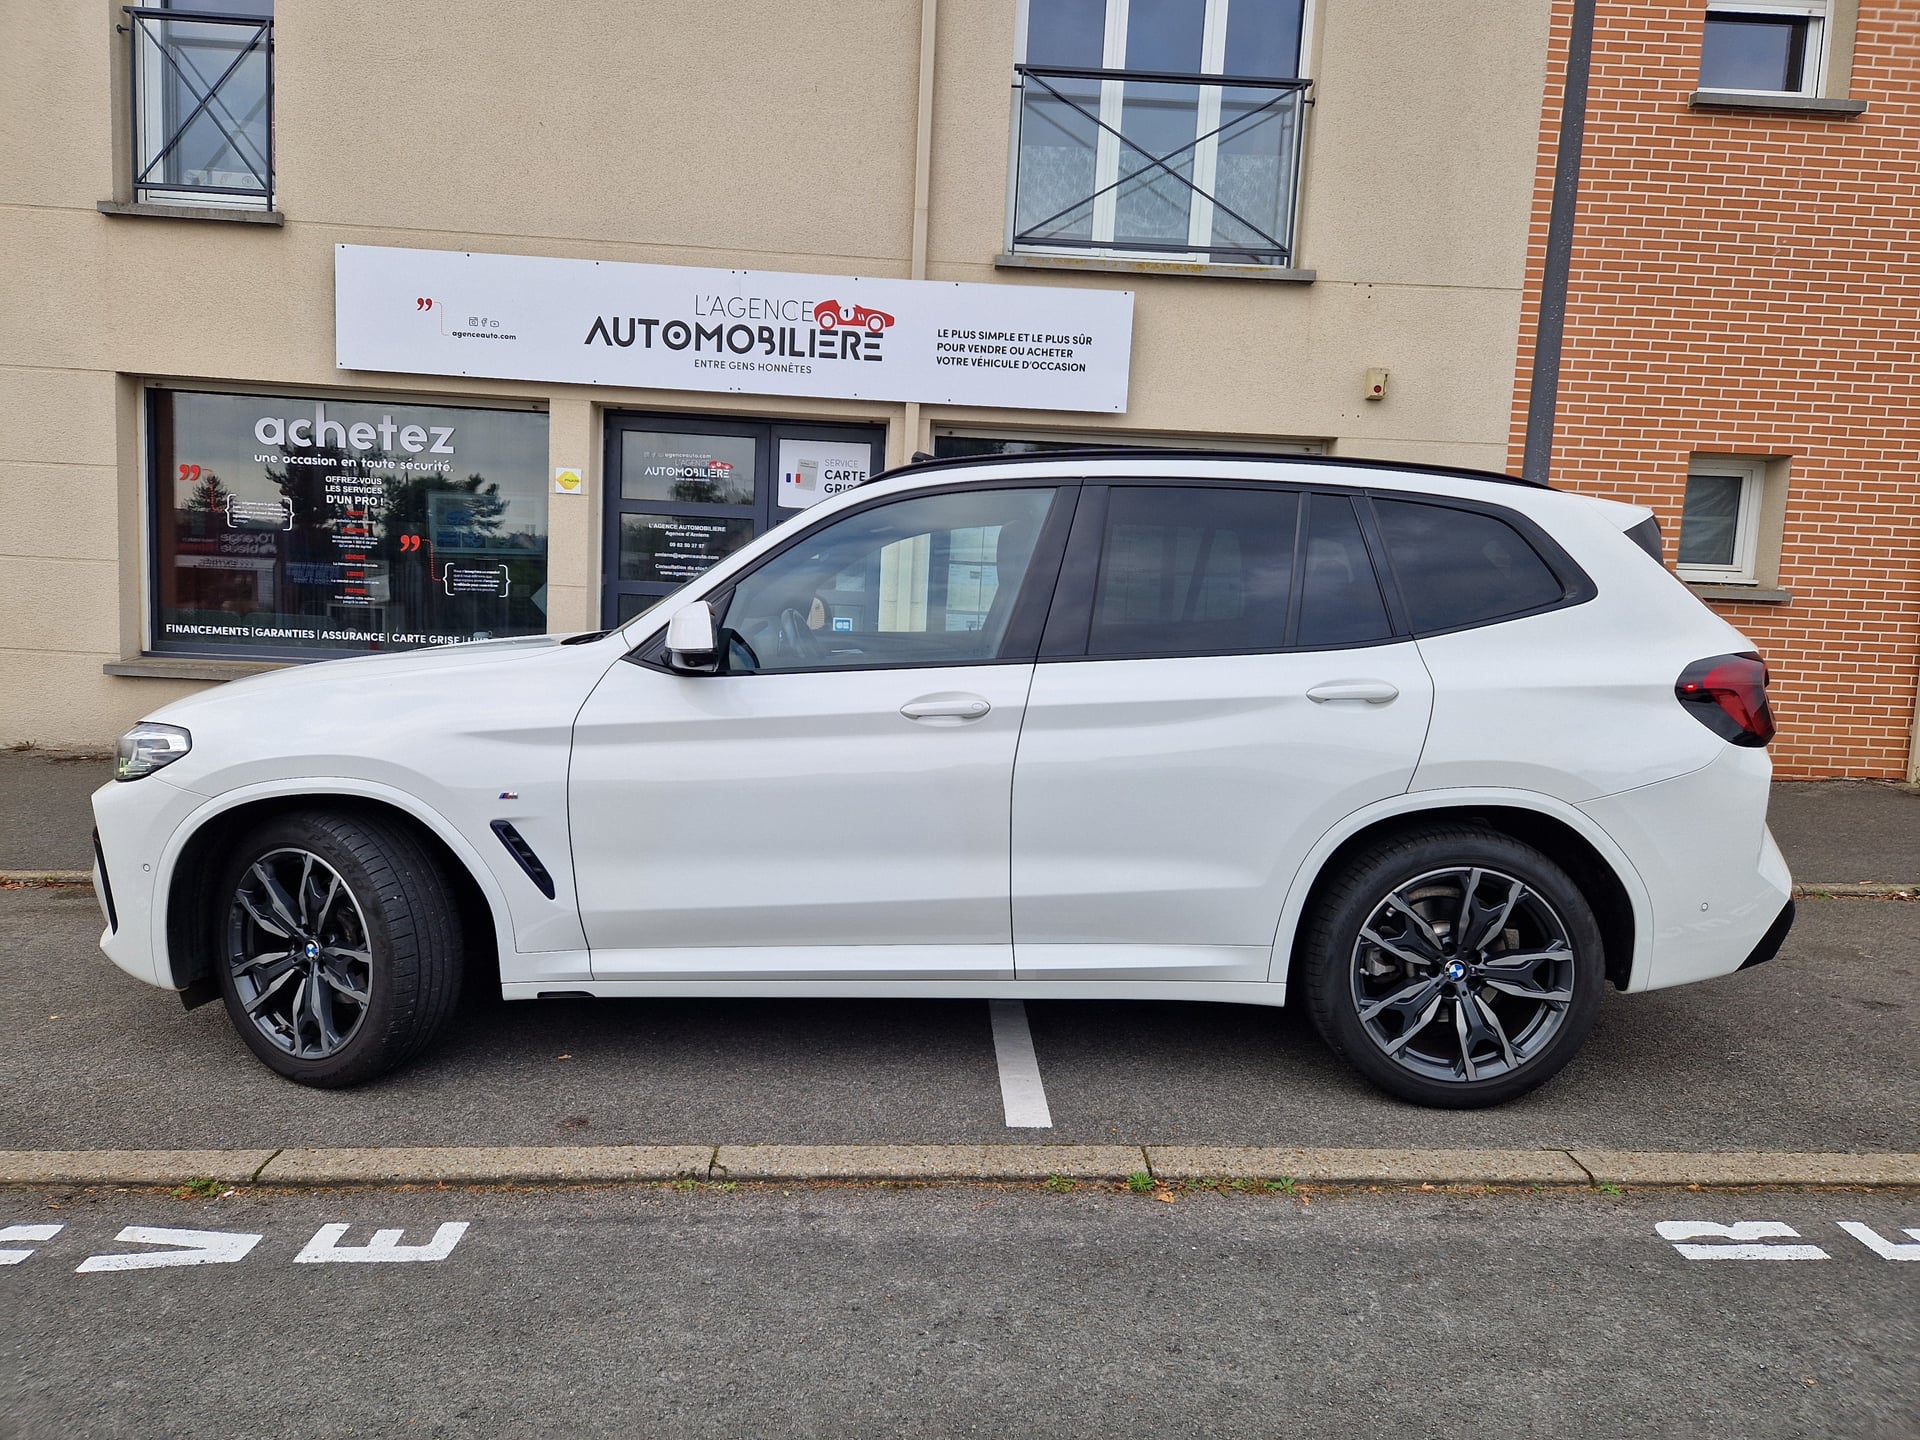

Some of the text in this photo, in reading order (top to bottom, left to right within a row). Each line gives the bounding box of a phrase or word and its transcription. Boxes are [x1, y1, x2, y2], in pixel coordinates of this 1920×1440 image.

[695, 294, 814, 323] L'AGENCE
[452, 331, 517, 340] agenceauto.com
[937, 329, 1093, 345] LE PLUS SIMPLE ET LE PLUS SÛR
[936, 342, 1073, 358] POUR VENDRE OU ACHETER
[694, 359, 812, 374] ENTRE GENS HONNÊTES
[936, 355, 1086, 372] VOTRE VÉHICULE D'OCCASION
[254, 402, 456, 454] achetez
[254, 454, 454, 472] une occasion en toute sécurité.
[824, 459, 859, 468] SERVICE
[325, 475, 382, 485] OFFREZ-VOUS
[824, 469, 866, 481] CARTE
[325, 485, 383, 494] LES SERVICES
[326, 494, 352, 505] D'UN
[354, 496, 378, 506] PRO
[165, 623, 460, 645] FINANCEMENTS GARANTIES ASSURANCE CARTE GRISE
